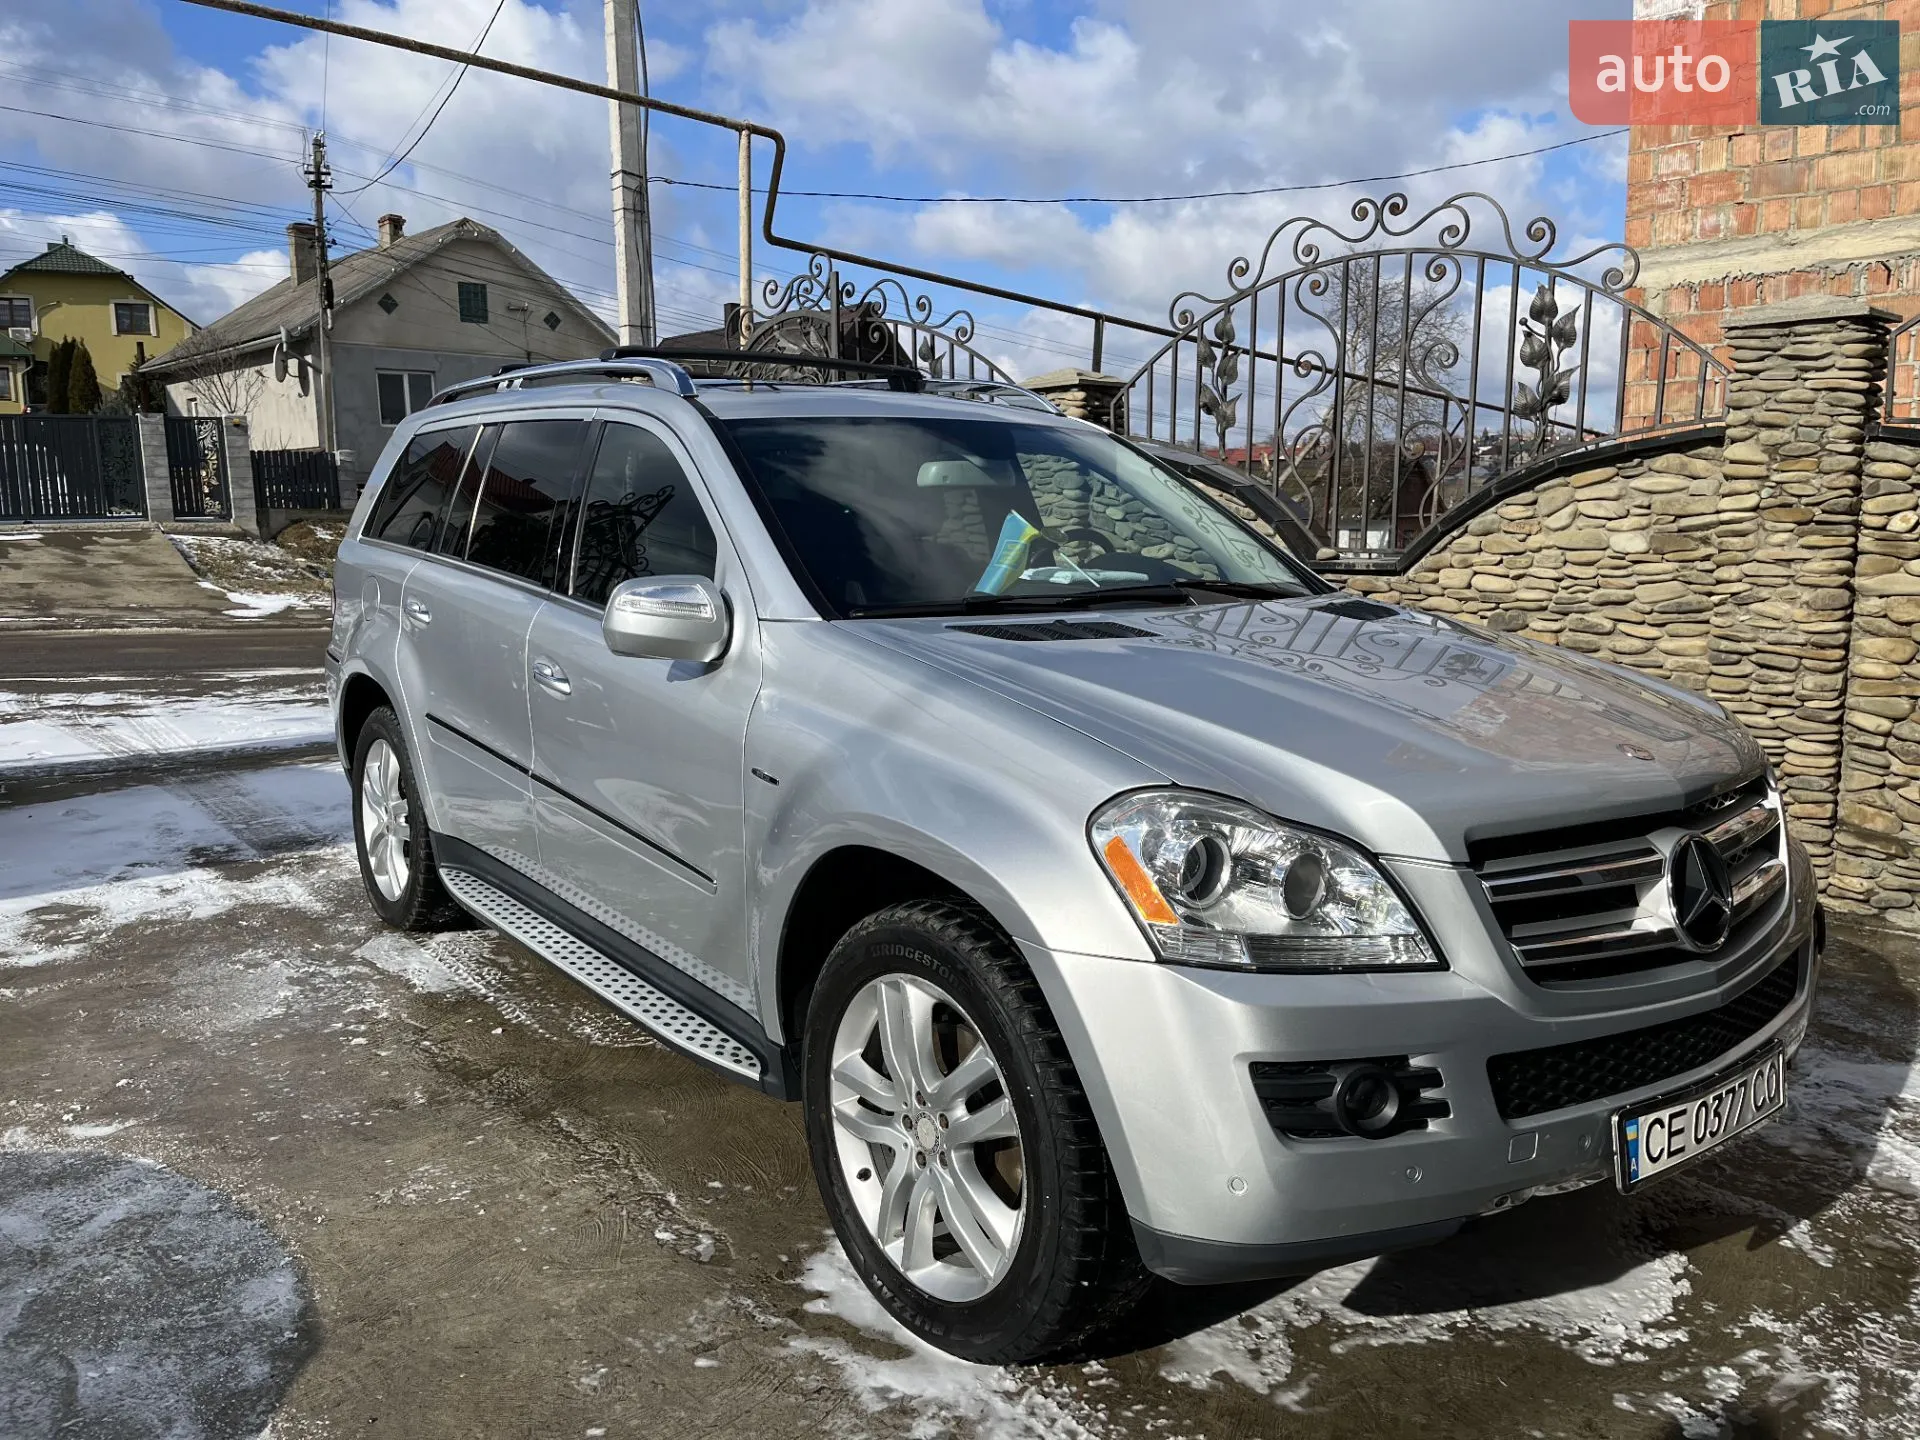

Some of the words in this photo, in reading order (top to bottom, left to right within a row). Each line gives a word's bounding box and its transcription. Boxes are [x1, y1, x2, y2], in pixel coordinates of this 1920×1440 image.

[869, 943, 969, 996] BRIDGESTO
[1645, 1108, 1688, 1164] CE
[1692, 1079, 1748, 1145] 0377
